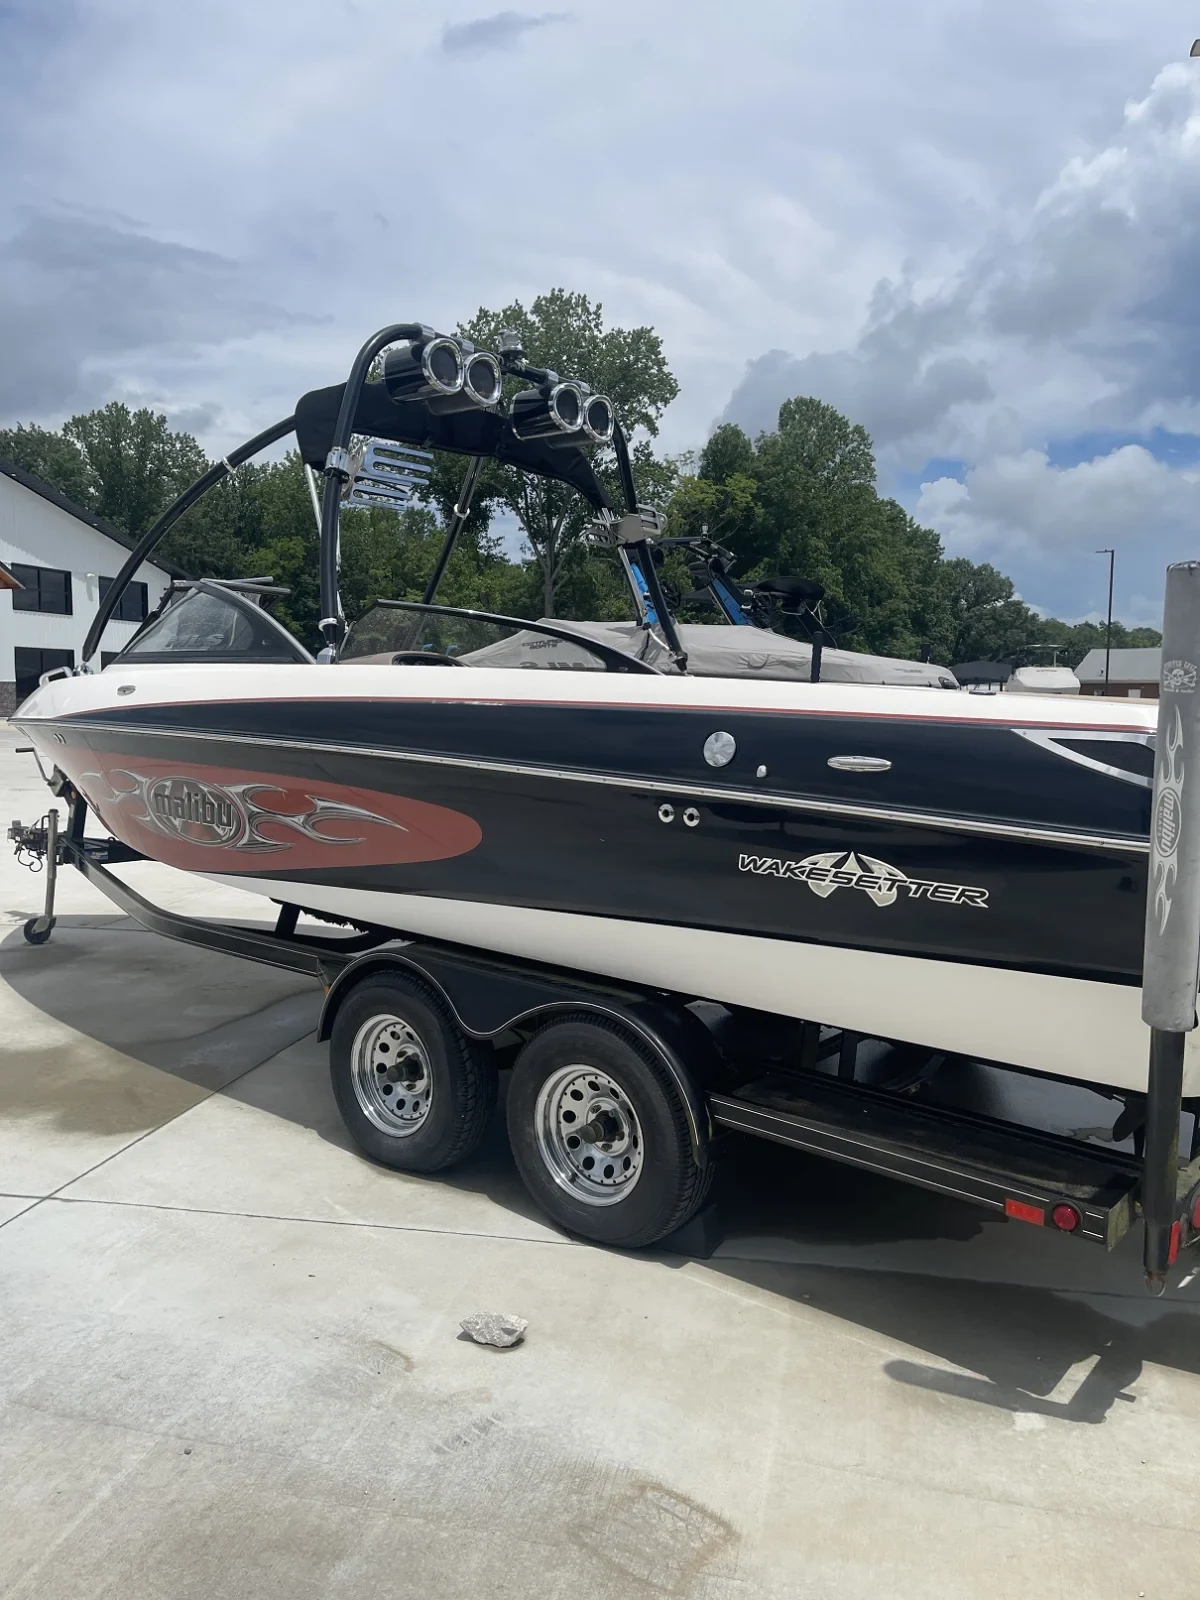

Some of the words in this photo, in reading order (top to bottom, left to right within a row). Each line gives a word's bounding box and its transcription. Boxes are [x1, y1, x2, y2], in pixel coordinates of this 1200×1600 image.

[154, 791, 232, 829] malibu
[1162, 793, 1176, 852] malibu
[738, 854, 989, 908] WAKESETTER
